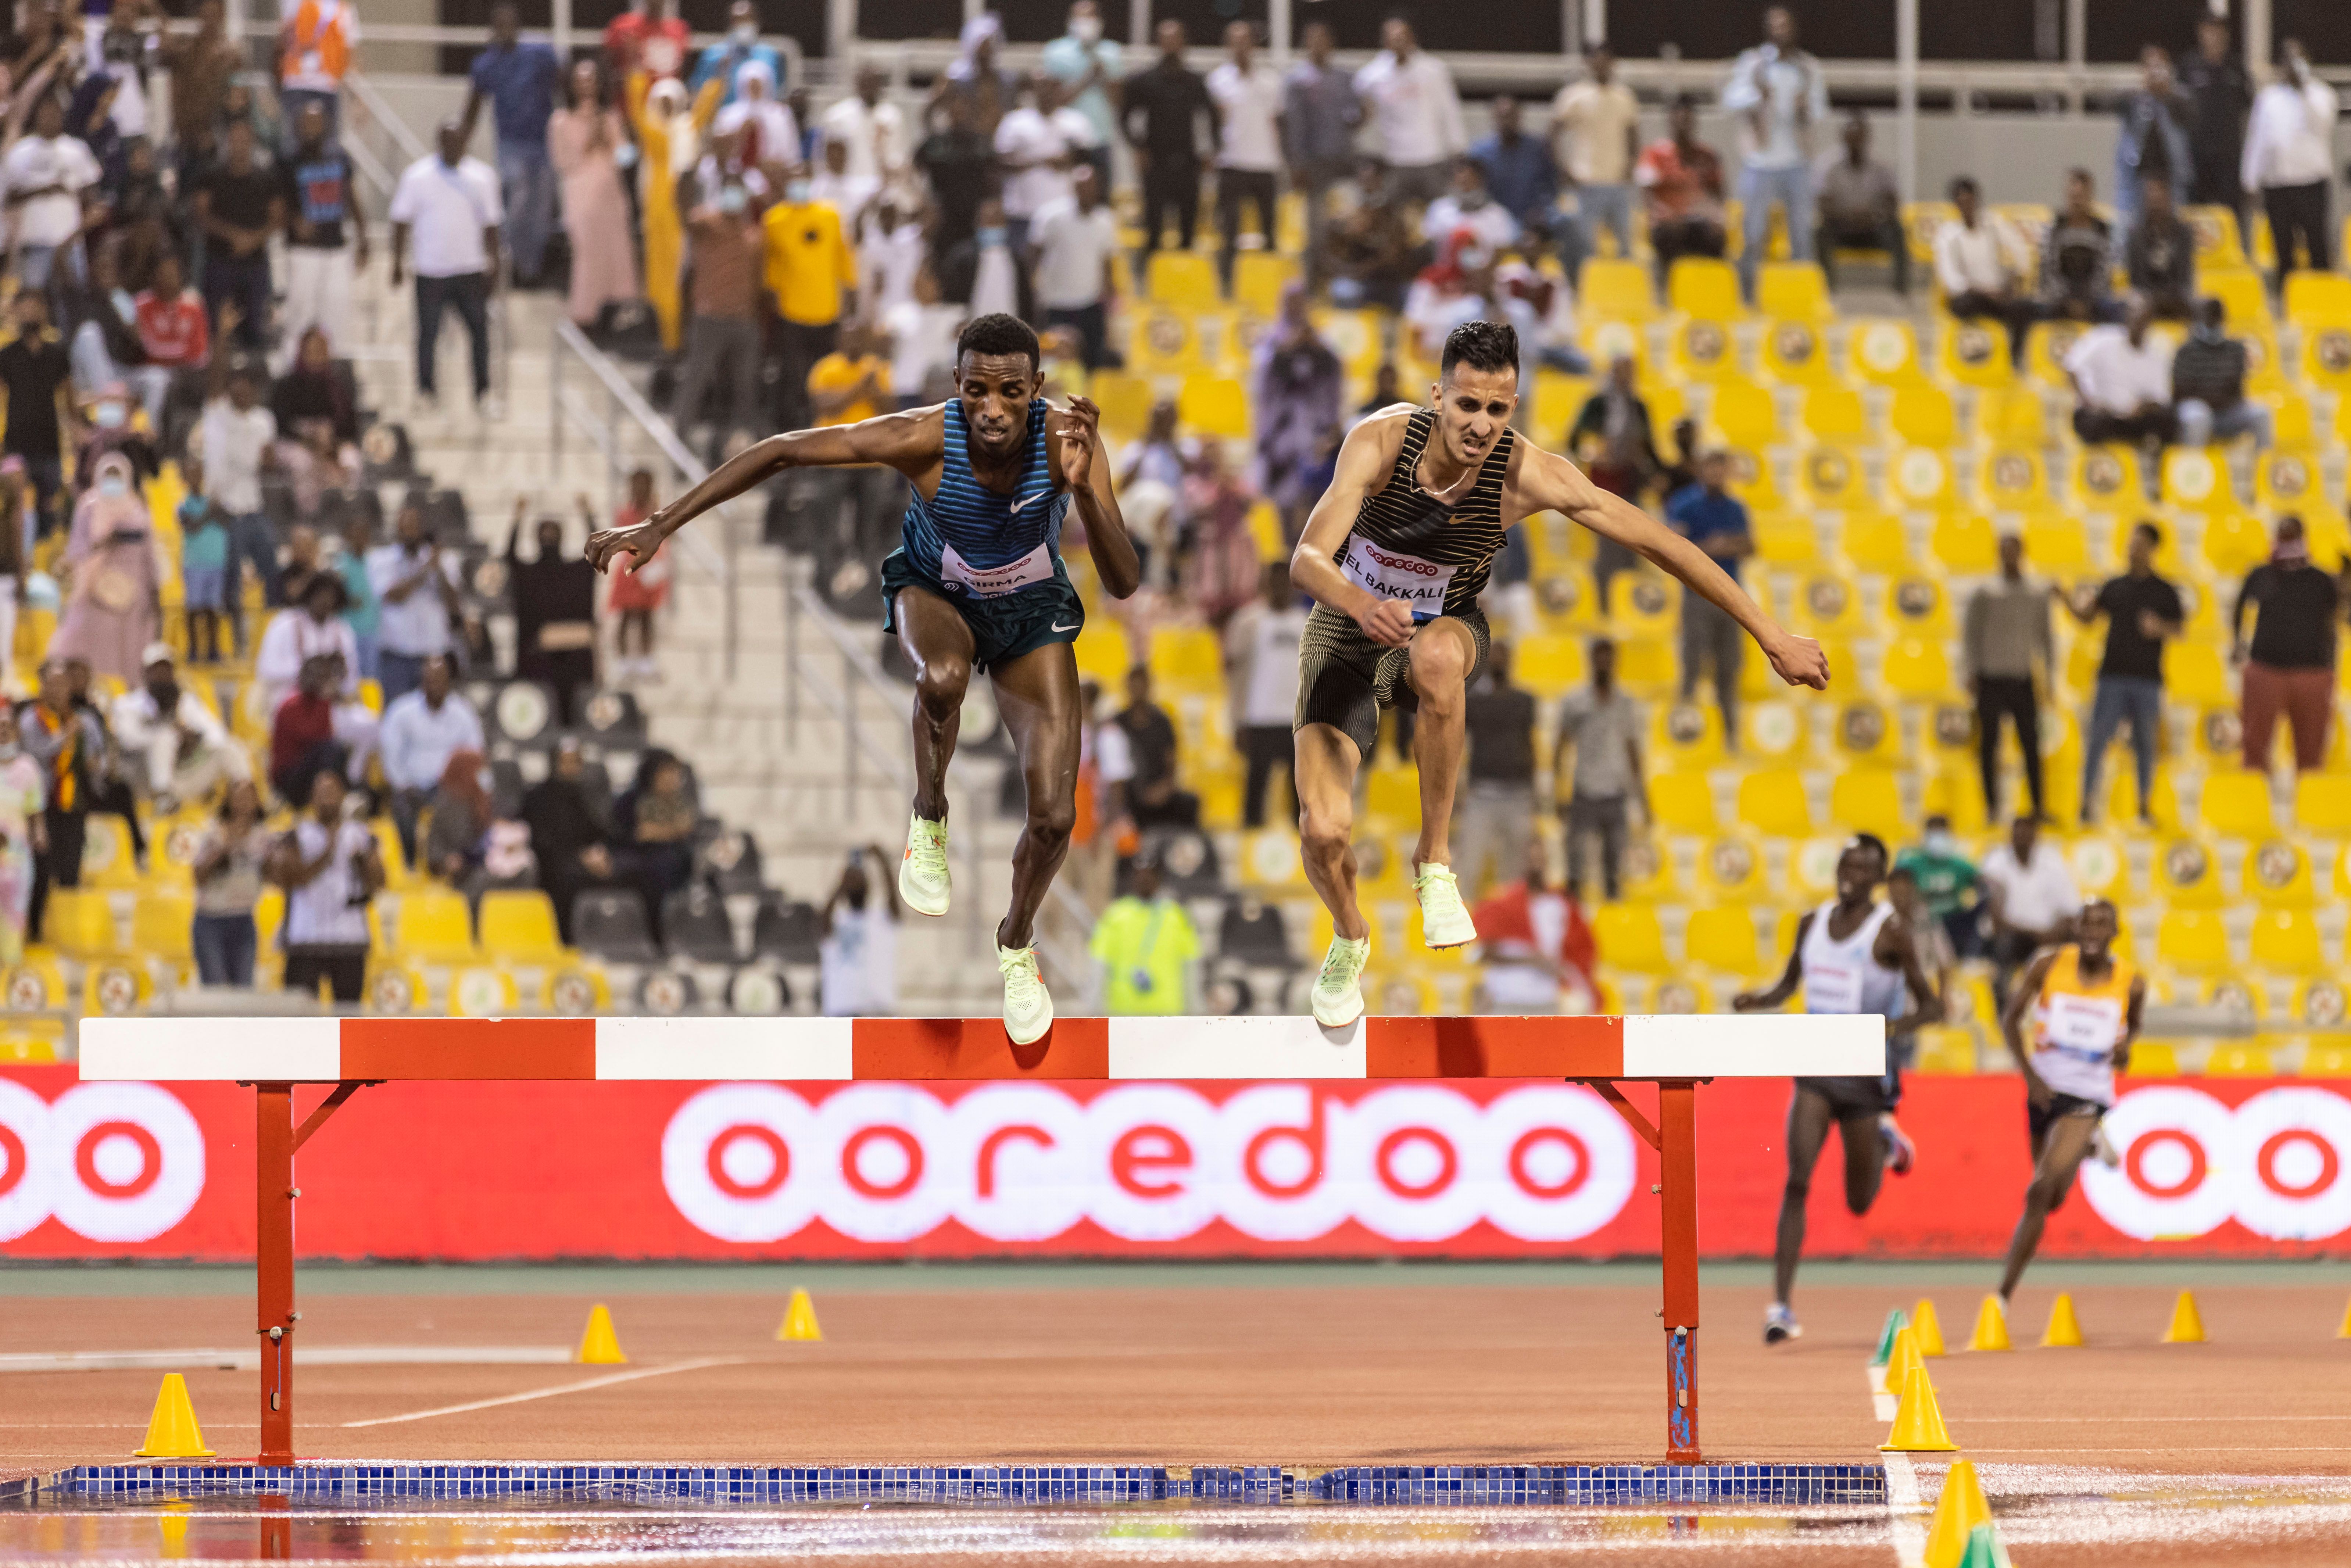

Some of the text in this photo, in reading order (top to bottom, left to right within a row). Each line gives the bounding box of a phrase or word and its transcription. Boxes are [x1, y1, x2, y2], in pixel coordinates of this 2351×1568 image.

[1345, 553, 1443, 599] EL BAKKALI
[1366, 545, 1438, 576] ooredoo
[964, 575, 1027, 587] GIRMA
[705, 1086, 1592, 1202] ooredoo
